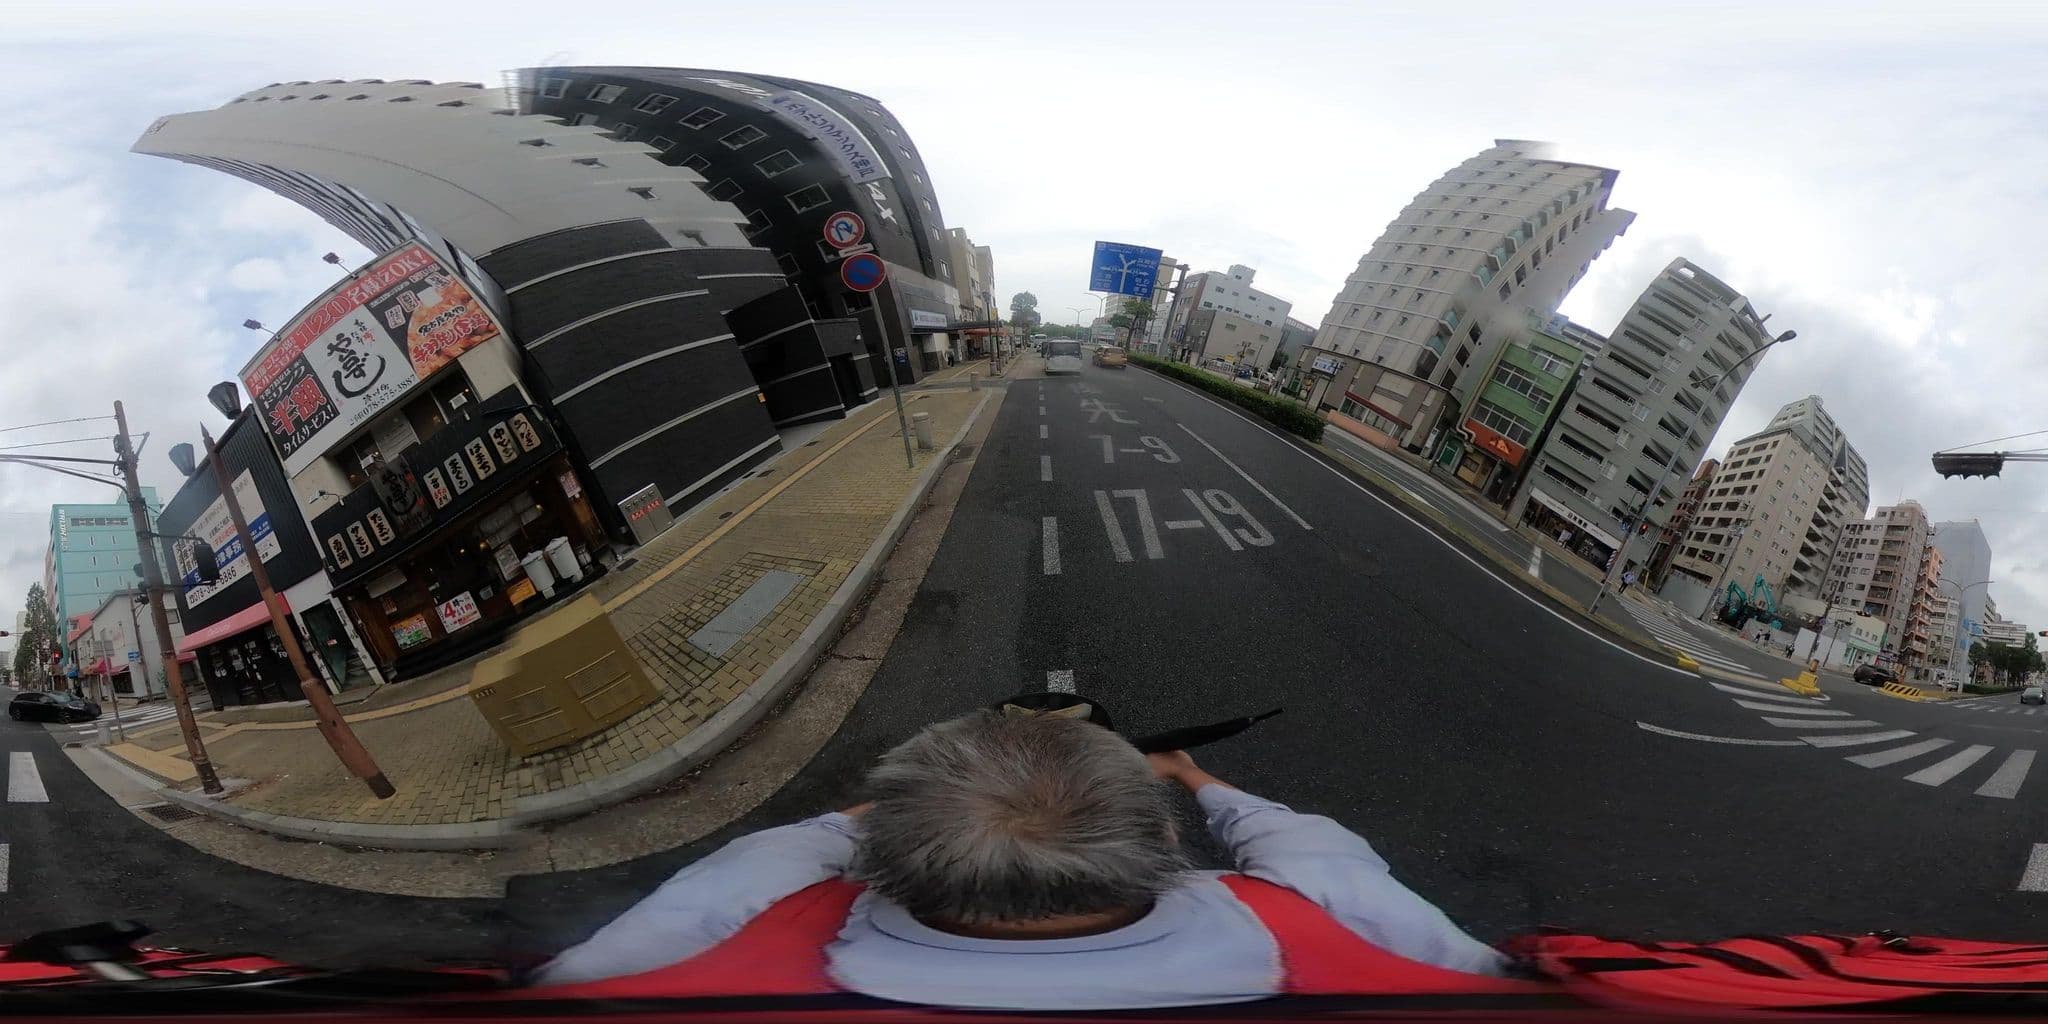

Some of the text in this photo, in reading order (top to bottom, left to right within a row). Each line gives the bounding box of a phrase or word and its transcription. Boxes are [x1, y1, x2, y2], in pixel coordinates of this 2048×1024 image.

[263, 365, 306, 408] ドリンク
[268, 376, 327, 436] 半額
[469, 443, 491, 474] はまち
[1088, 434, 1181, 464] 7-9
[350, 526, 370, 554] サーモン
[1093, 488, 1276, 563] 17-19
